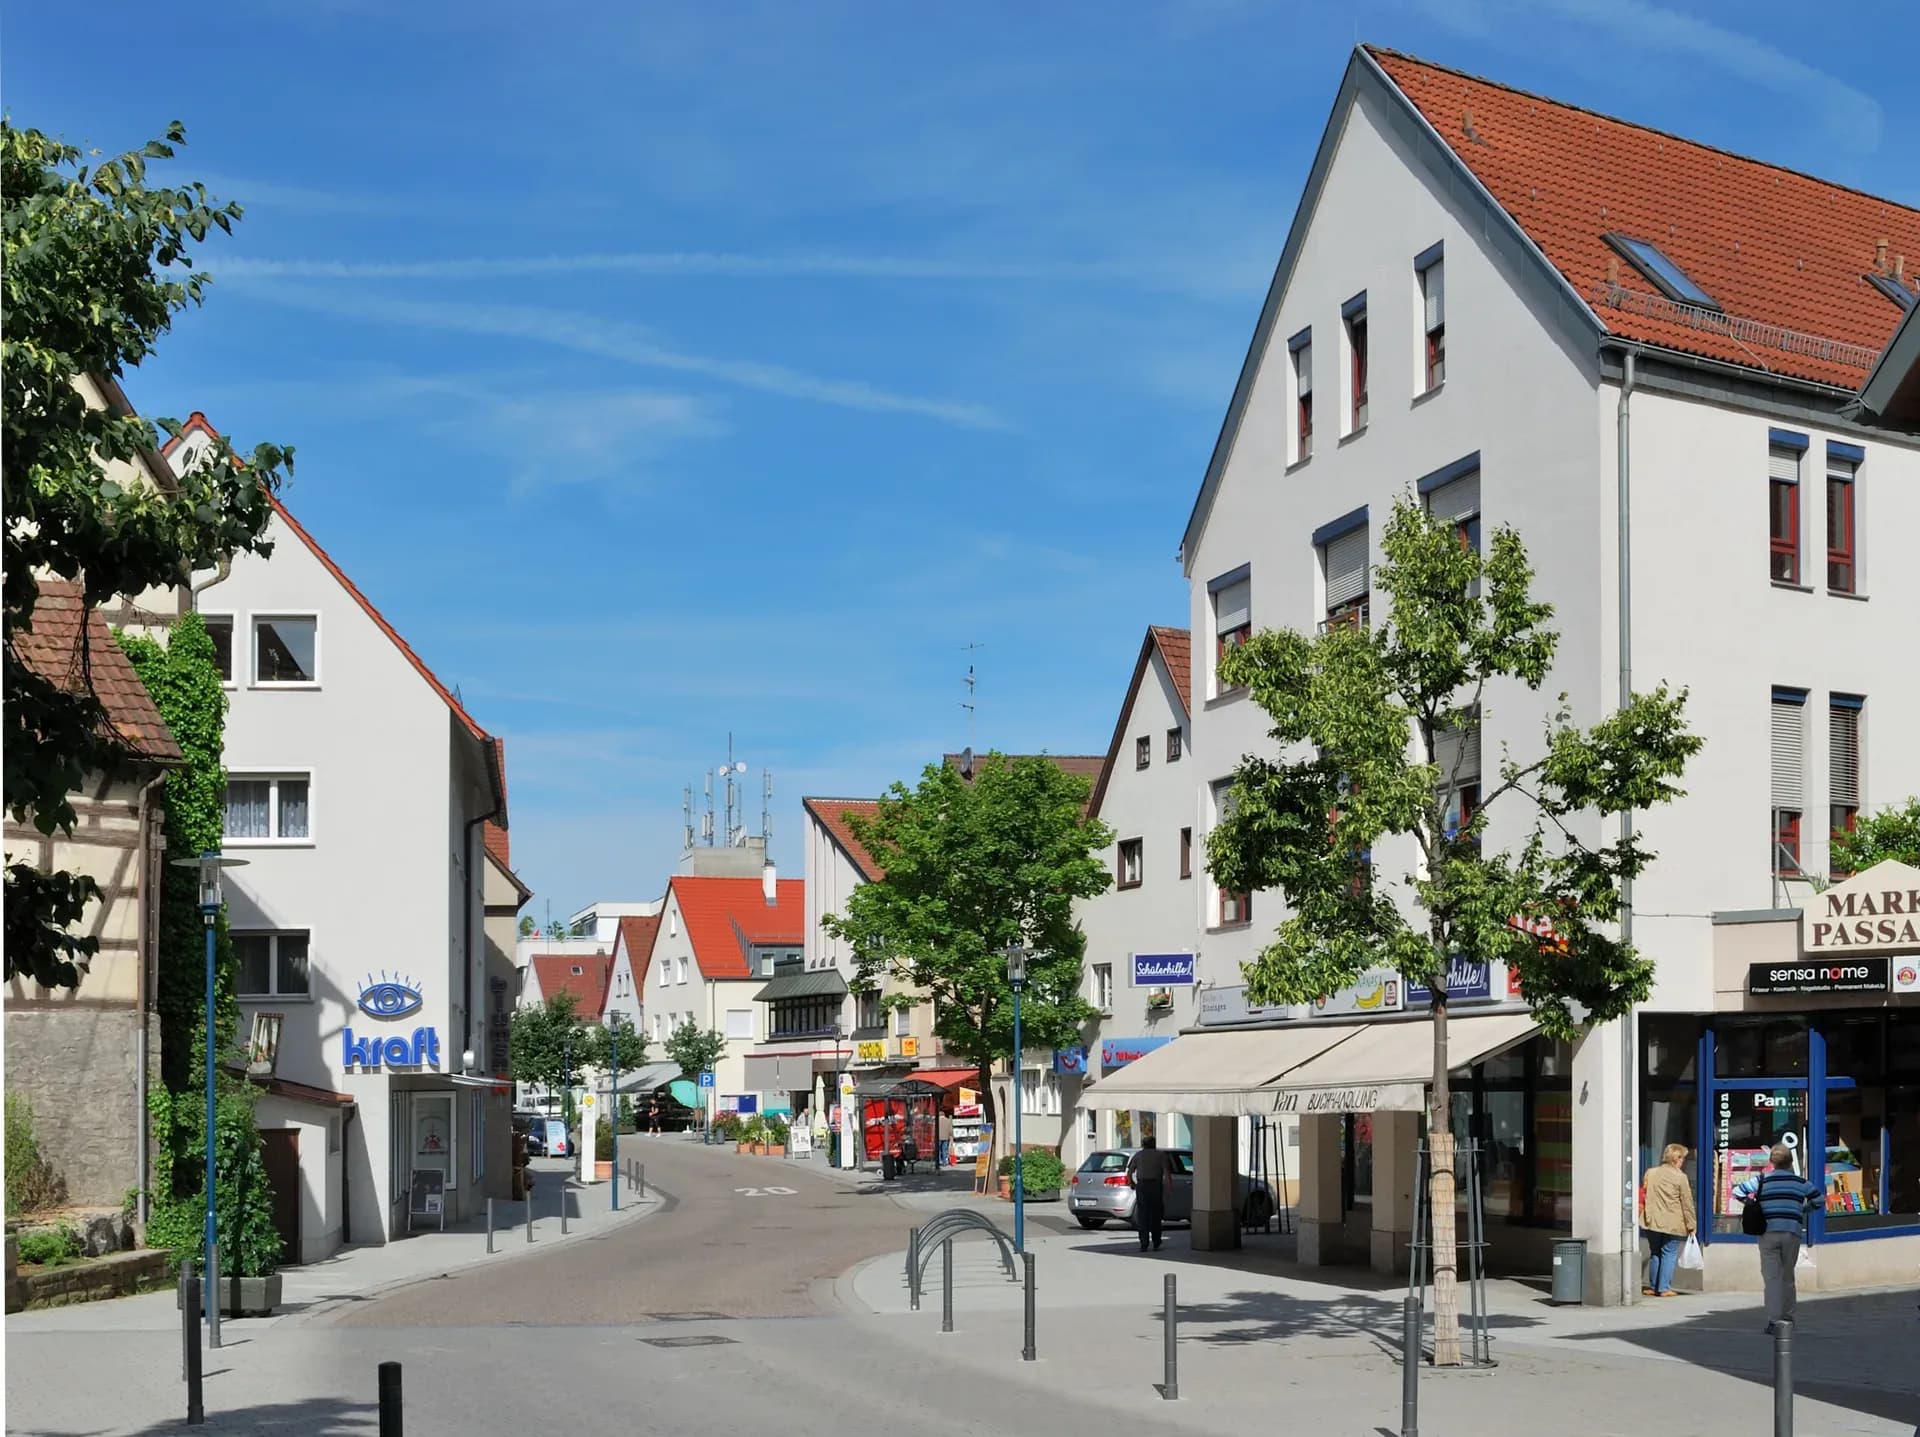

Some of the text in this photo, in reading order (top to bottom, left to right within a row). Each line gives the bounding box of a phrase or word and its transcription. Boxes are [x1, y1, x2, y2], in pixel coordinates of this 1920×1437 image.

[1769, 966, 1869, 981] sensa nome
[342, 1027, 440, 1067] kraft
[1273, 1089, 1378, 1111] Pan BUCHHANDLUNG
[1753, 1093, 1787, 1107] Pan
[734, 1186, 799, 1196] 20
